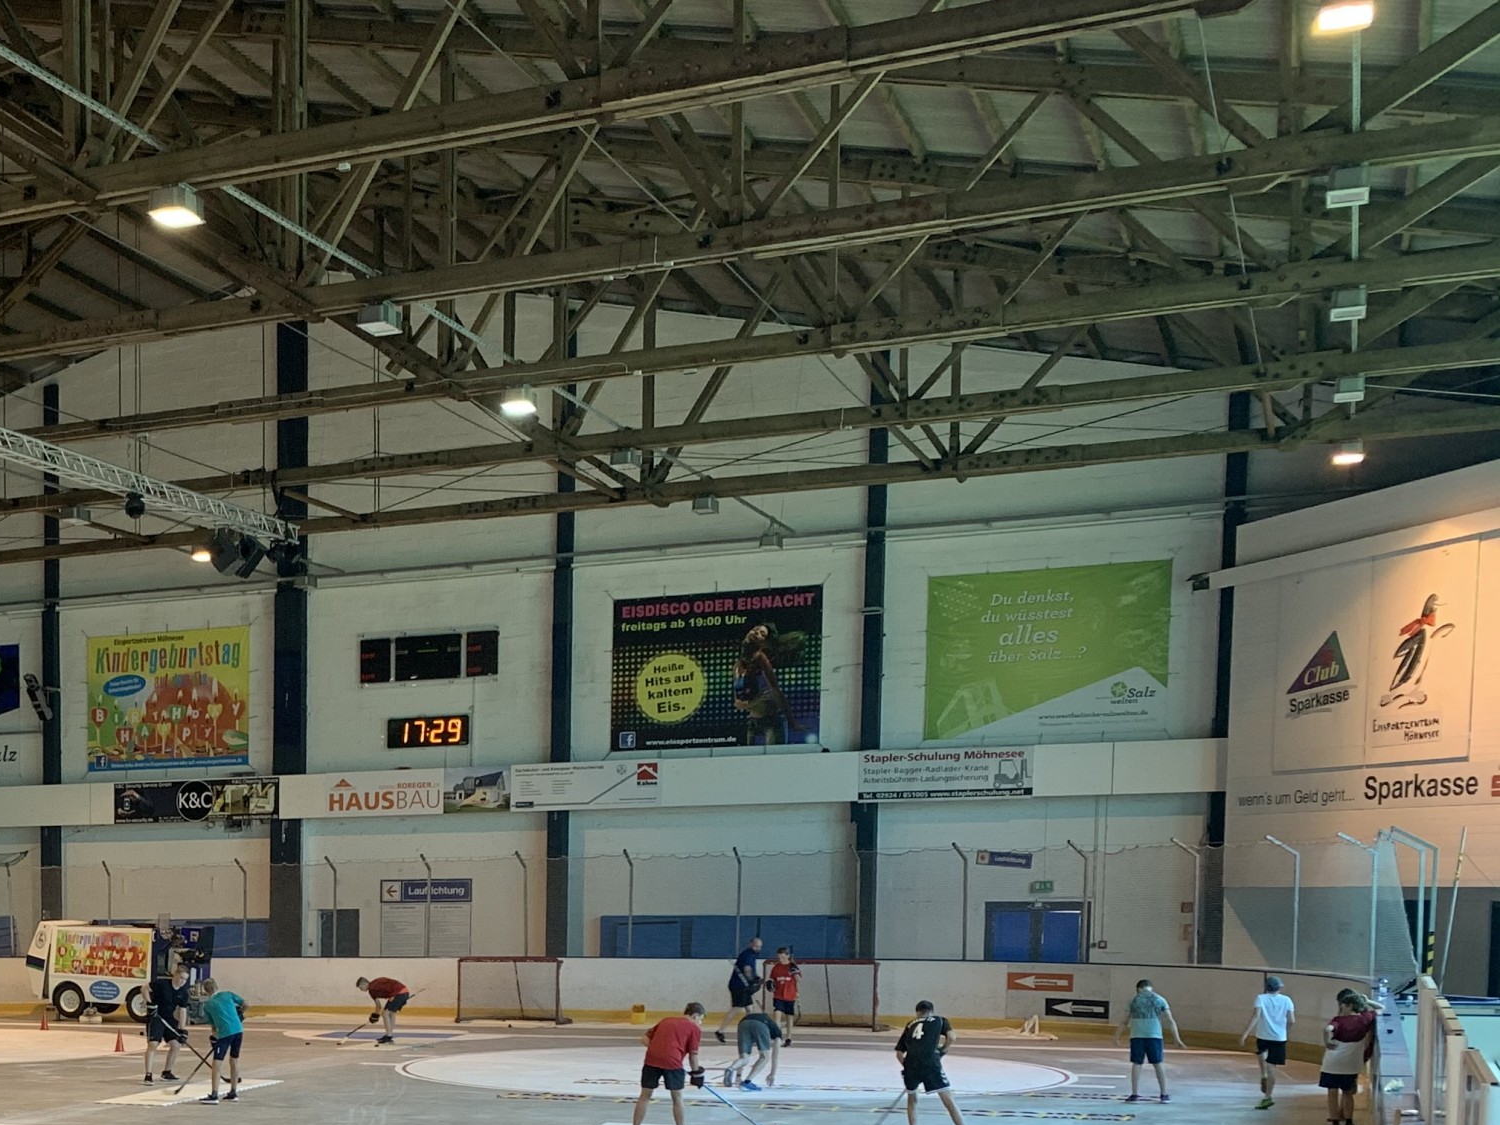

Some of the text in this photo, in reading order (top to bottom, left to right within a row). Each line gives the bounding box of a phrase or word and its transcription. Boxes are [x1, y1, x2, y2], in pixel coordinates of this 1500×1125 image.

[621, 592, 815, 618] EISDISCO ODER EISNACHT
[990, 589, 1074, 606] Du denkst,
[621, 614, 747, 632] freitags ab 19:00 Uhr
[981, 607, 1073, 623] du wüsstest
[999, 623, 1060, 646] alles
[95, 640, 241, 674] Kindergeburtstag
[988, 650, 1022, 663] über
[1027, 648, 1061, 661] Salz
[653, 662, 684, 674] Heiße
[1304, 661, 1340, 685] Club
[645, 671, 695, 687] Hits auf
[647, 686, 693, 700] kaltem
[1126, 685, 1156, 698] Salz
[656, 701, 686, 714] Eis.
[1110, 697, 1139, 705] welten
[1289, 688, 1350, 714] Sparkasse
[403, 719, 461, 743] 17:29
[863, 750, 1025, 765] Stapler-Schulung Möhnesee
[930, 788, 1024, 798] www.staplerschulung.net
[1275, 793, 1291, 805] um
[1294, 789, 1318, 804] Geld
[1364, 773, 1479, 805] Sparkasse
[178, 791, 213, 809] K&C
[329, 789, 441, 812] HAUSBAU
[912, 1022, 924, 1039] 4
